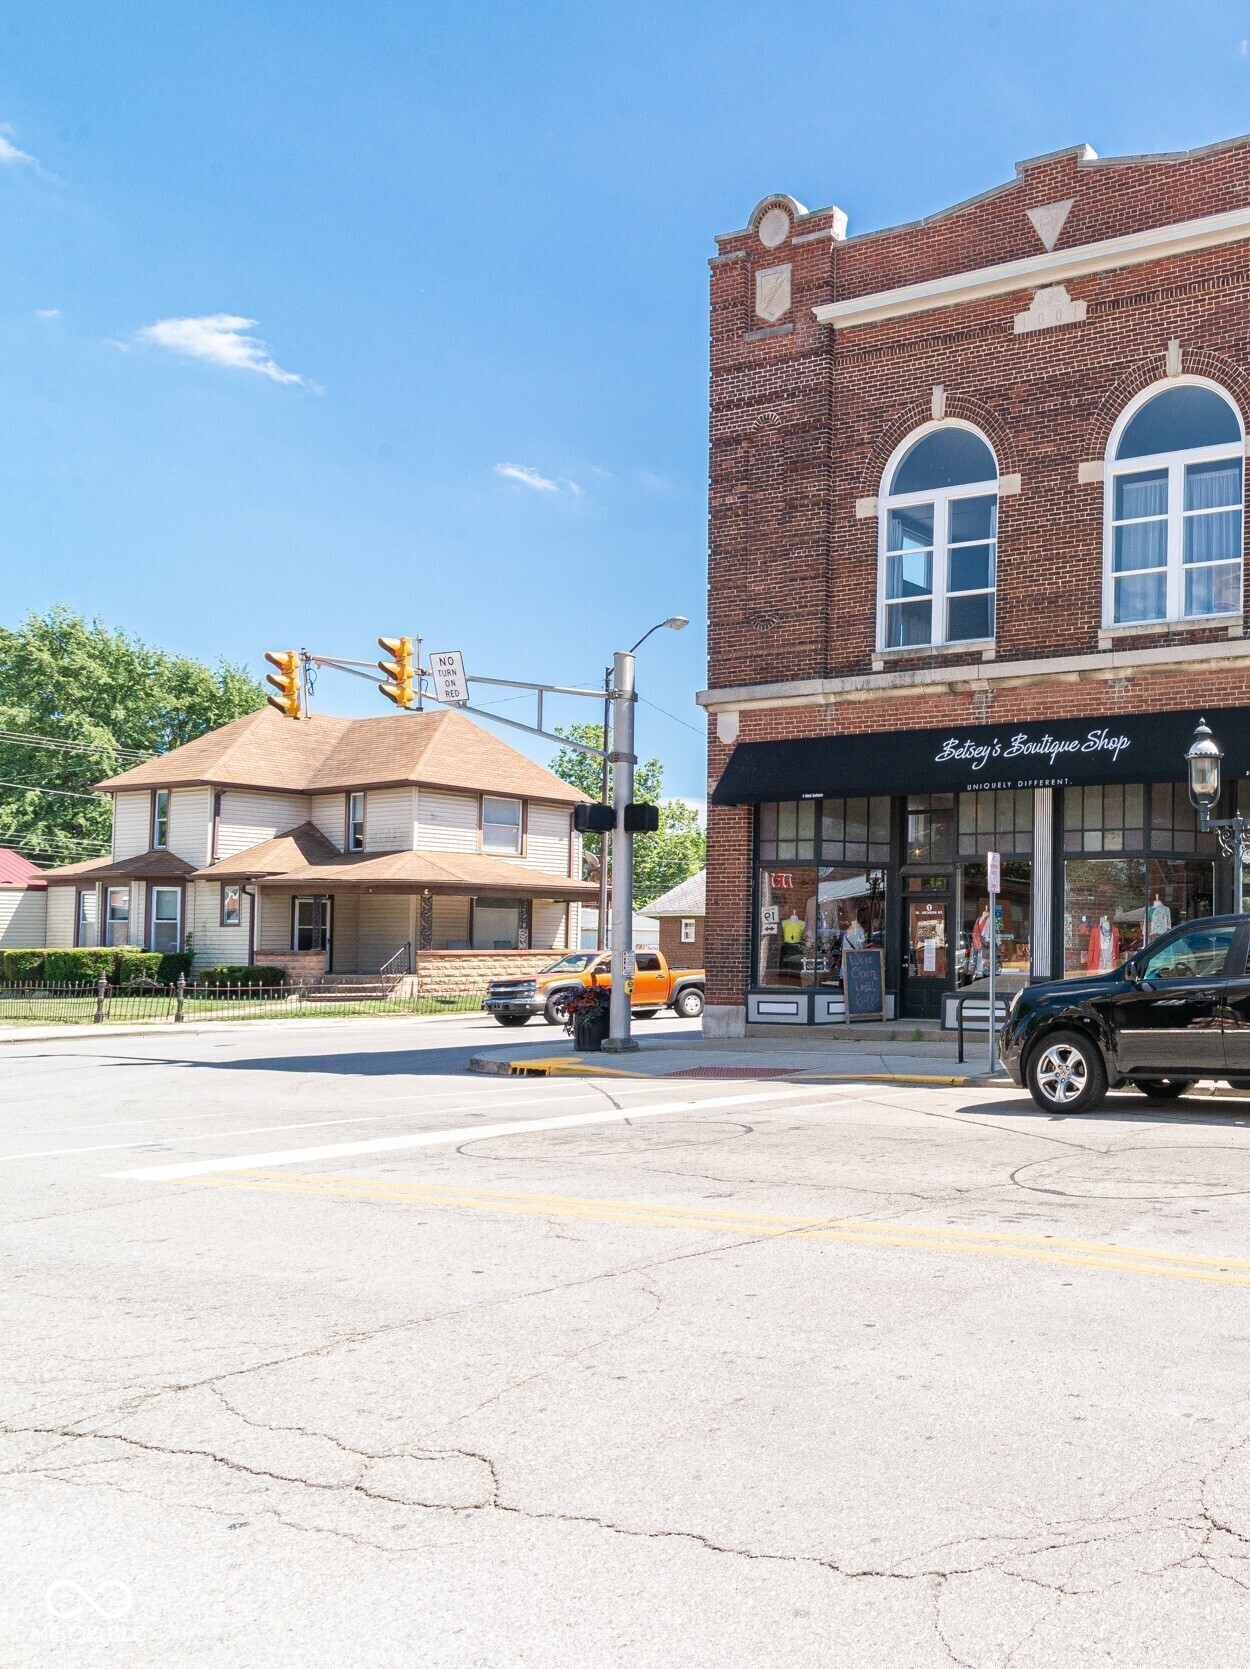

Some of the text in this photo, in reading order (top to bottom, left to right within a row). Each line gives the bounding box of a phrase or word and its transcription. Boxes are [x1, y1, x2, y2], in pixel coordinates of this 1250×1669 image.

[439, 656, 454, 666] NO
[437, 669, 457, 677] TURN
[445, 690, 460, 698] RED
[935, 728, 1131, 770] Betsey's Boutique Shop
[966, 778, 1073, 791] UNIQUELY DIFFERENT.
[851, 966, 878, 980] Open
